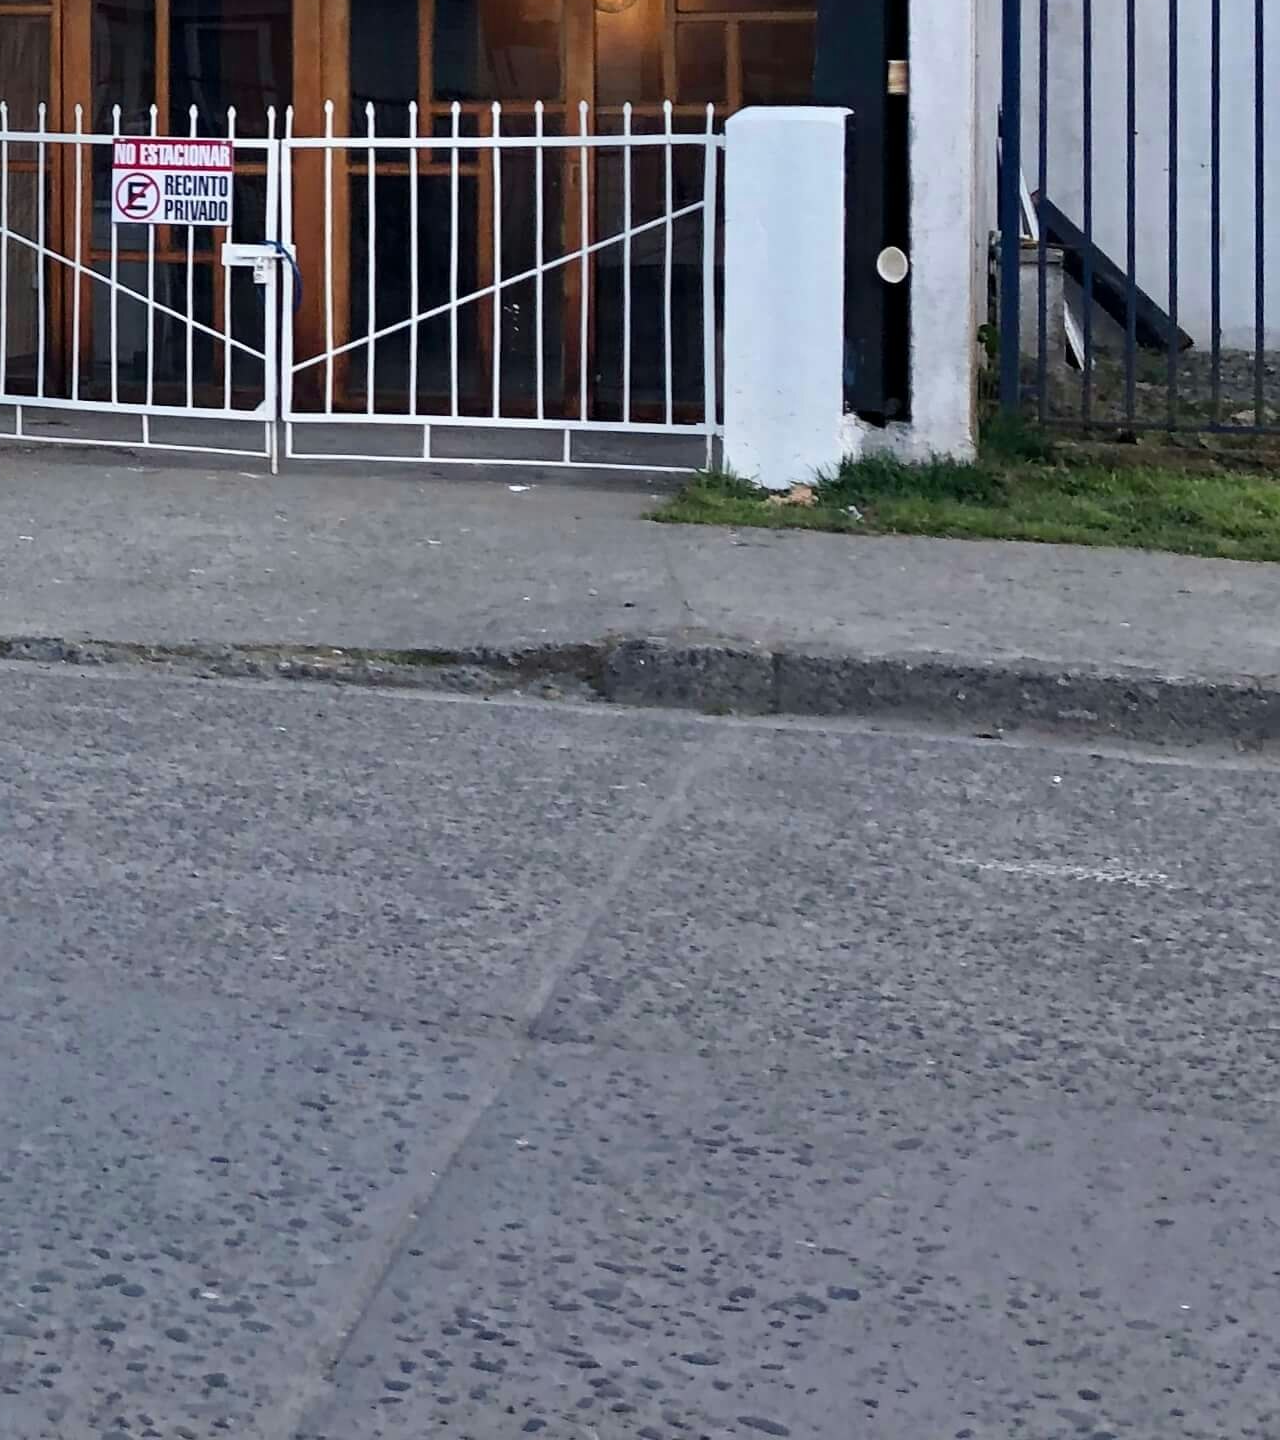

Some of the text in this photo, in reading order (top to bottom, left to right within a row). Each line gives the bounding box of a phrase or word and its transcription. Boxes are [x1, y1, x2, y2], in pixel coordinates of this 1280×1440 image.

[114, 143, 230, 167] NO ESTACIONAR
[164, 175, 228, 197] RECINTO
[164, 200, 228, 221] PRIVADO
